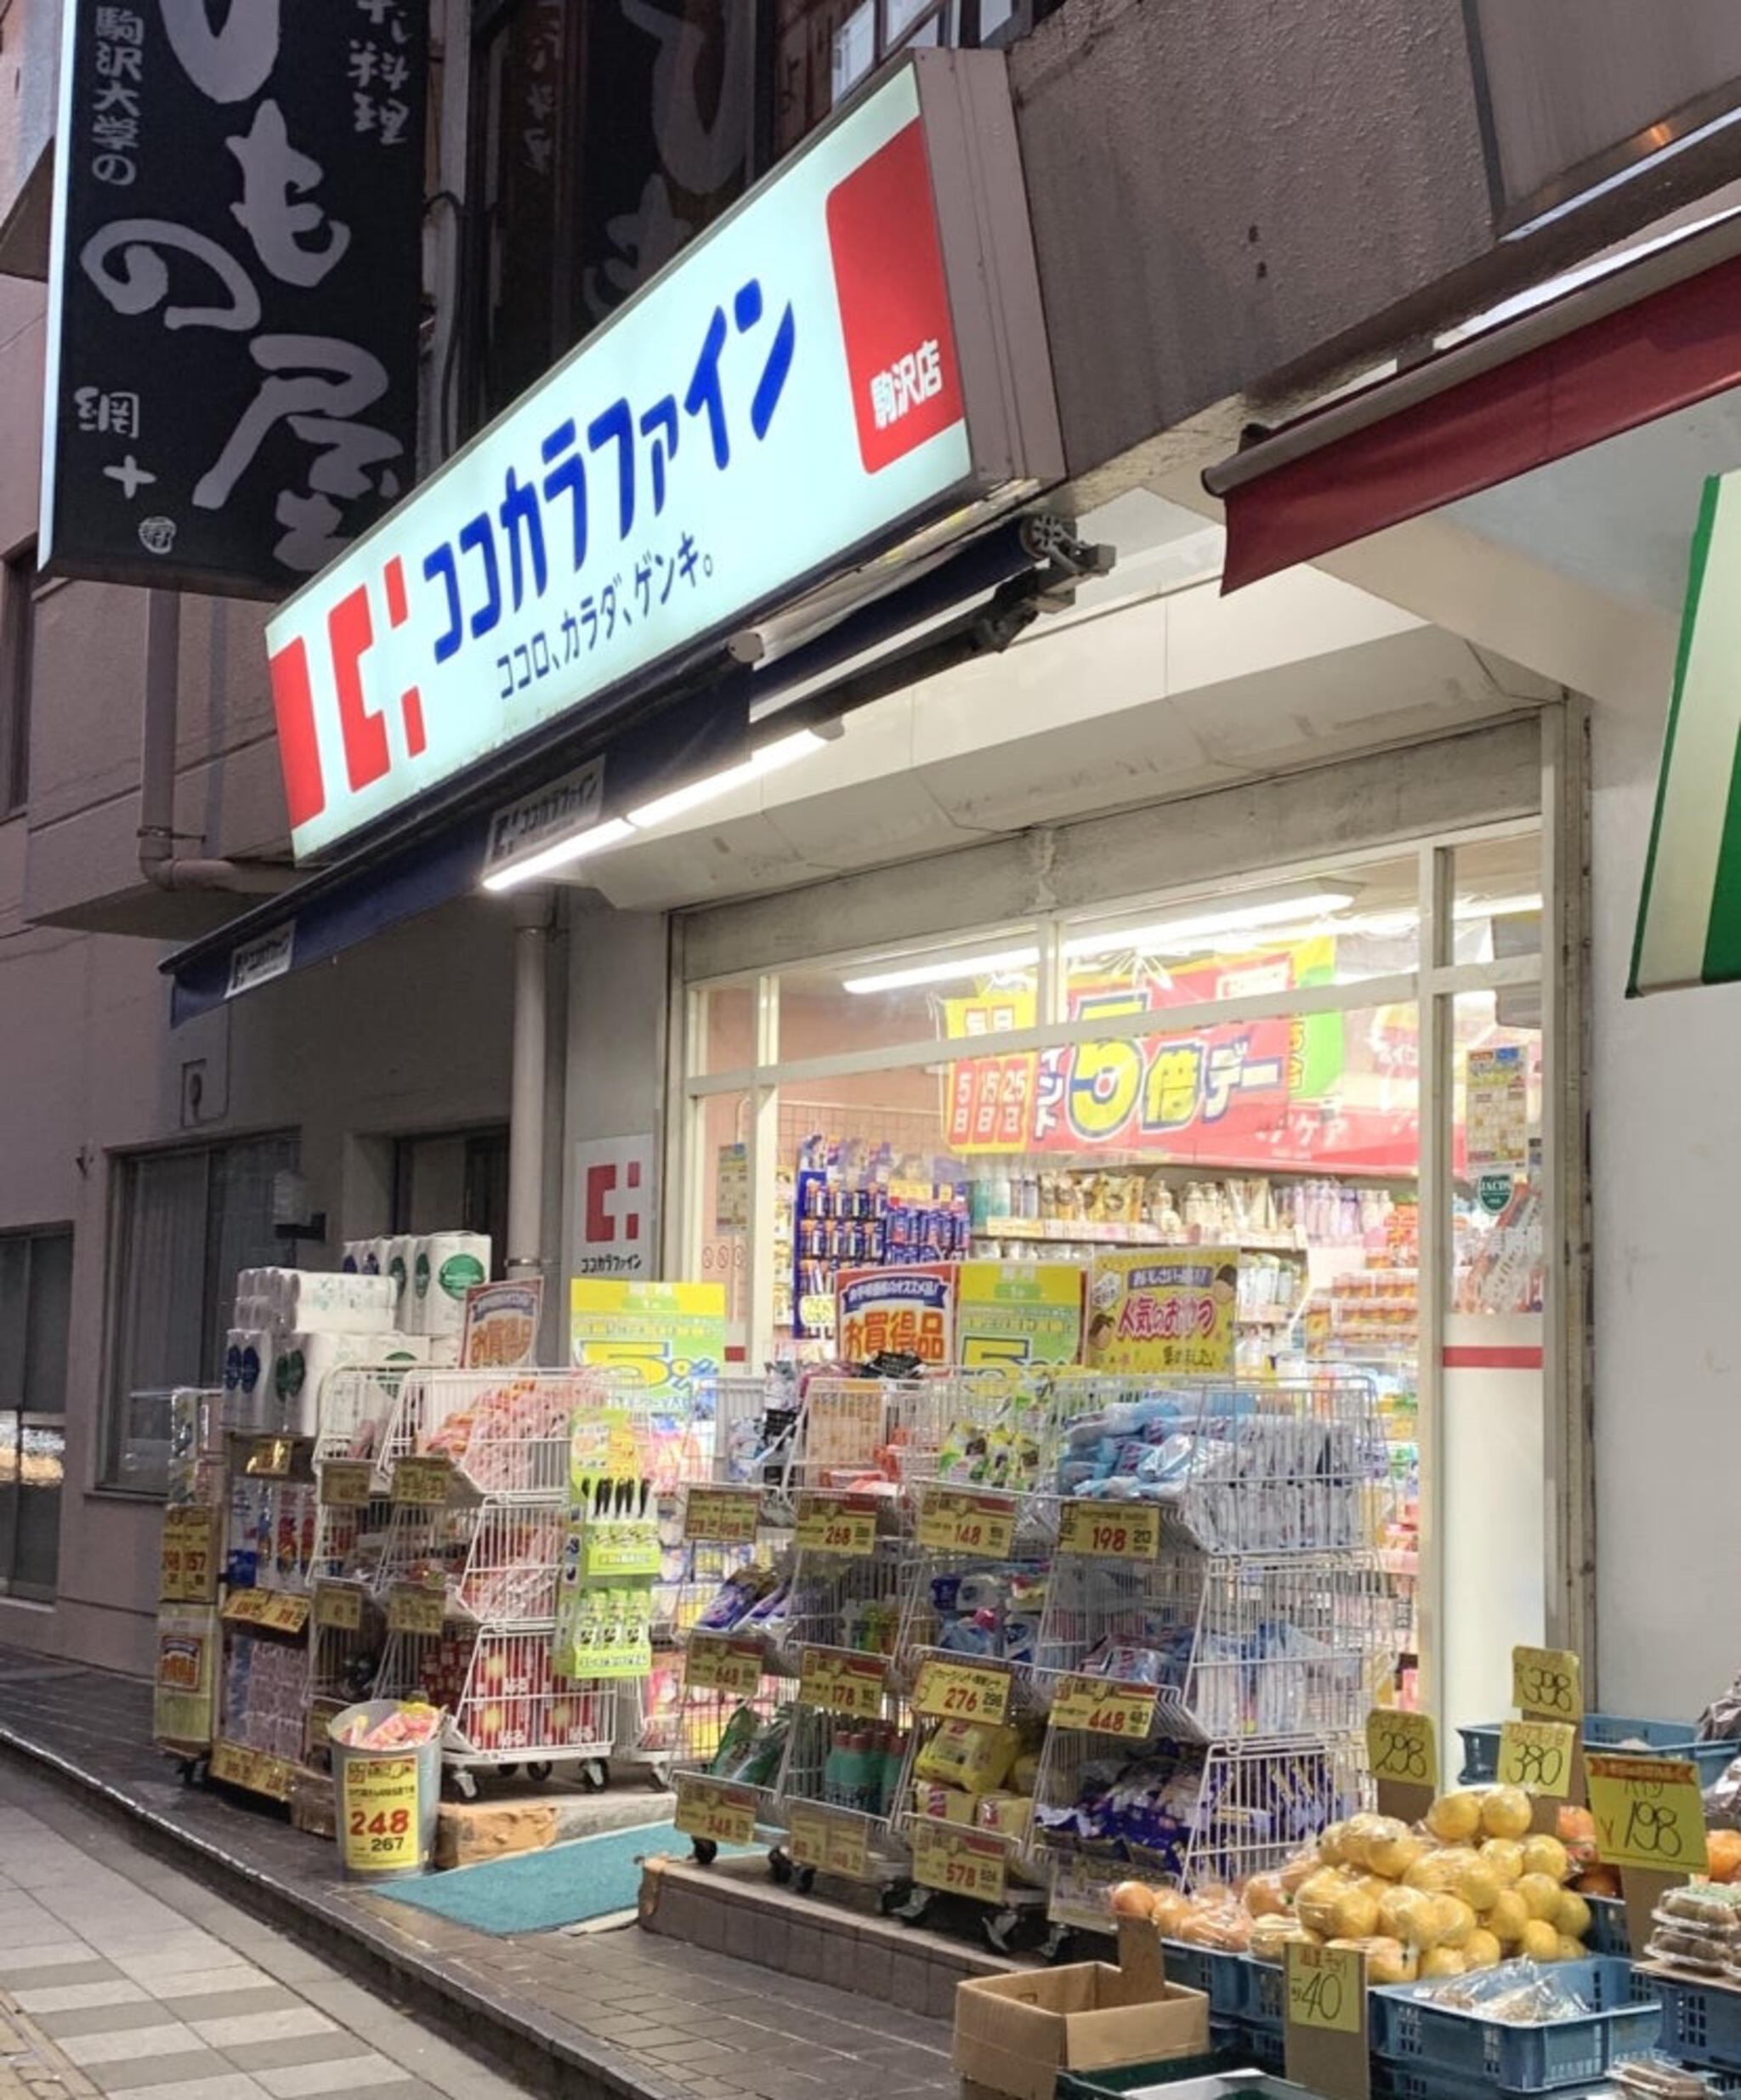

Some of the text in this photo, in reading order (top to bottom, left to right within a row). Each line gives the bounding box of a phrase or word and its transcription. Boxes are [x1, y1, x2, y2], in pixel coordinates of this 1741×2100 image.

[91, 6, 145, 185] 駒沢大学の
[870, 338, 943, 430] 駒沢店
[423, 278, 795, 664] ココカラファイン
[497, 531, 713, 700] ココロ、カラダ、ゲンキ。
[581, 1253, 642, 1274] ココカラファイン
[955, 1524, 982, 1547] 148
[1092, 1526, 1127, 1552] 198
[944, 1686, 978, 1711] 276
[1523, 1666, 1572, 1712] 398
[1088, 1708, 1126, 1732] 448
[1375, 1731, 1427, 1779] 298
[1506, 1742, 1563, 1785] 380
[349, 1808, 410, 1836] 248
[1625, 1799, 1682, 1858] 198
[371, 1836, 404, 1852] 267
[946, 1862, 976, 1887] 578
[1301, 1971, 1342, 2021] 40
